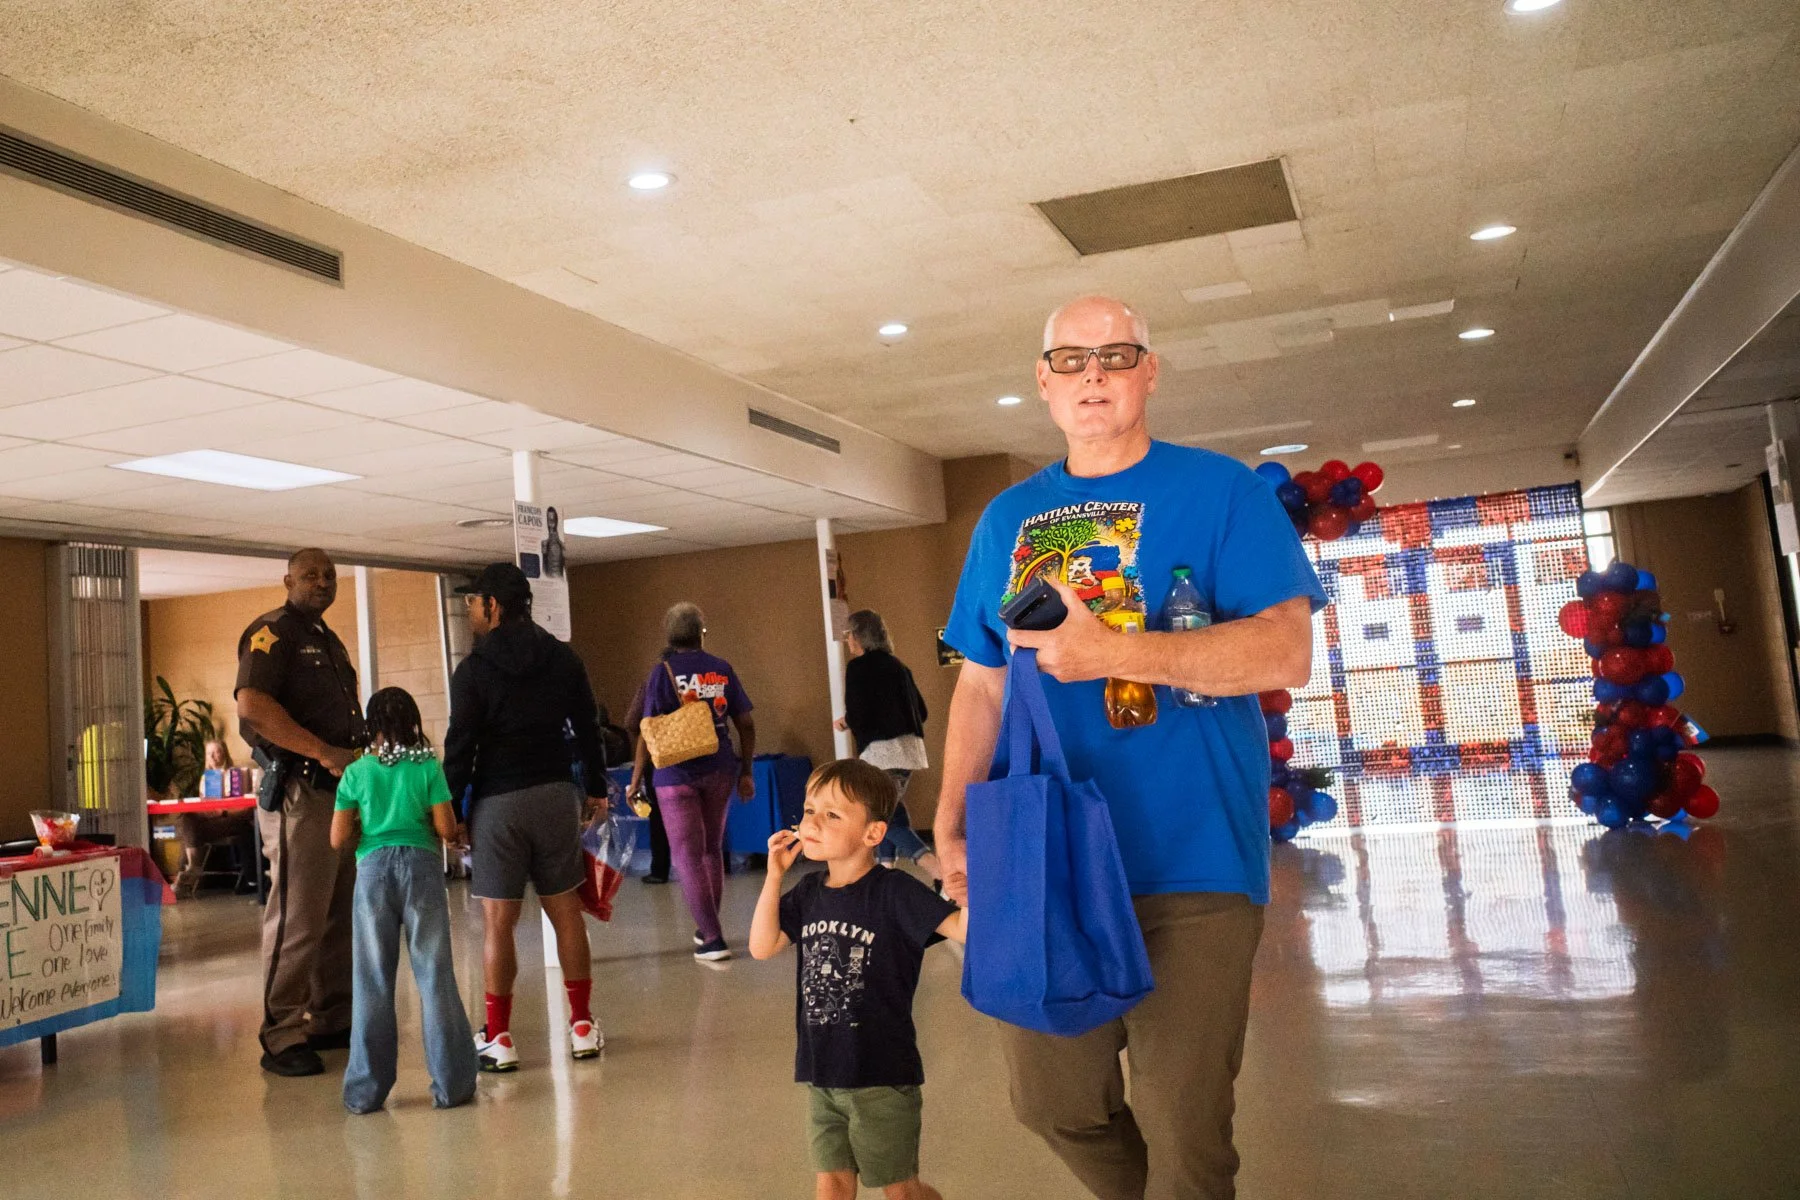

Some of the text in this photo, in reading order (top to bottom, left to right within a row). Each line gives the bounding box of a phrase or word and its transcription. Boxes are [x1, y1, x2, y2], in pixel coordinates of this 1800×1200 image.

[1024, 501, 1138, 527] HAITIAN CENTER
[1063, 511, 1106, 521] EVANSVILLE
[49, 923, 82, 952] One
[0, 926, 32, 979] E
[42, 956, 71, 978] one
